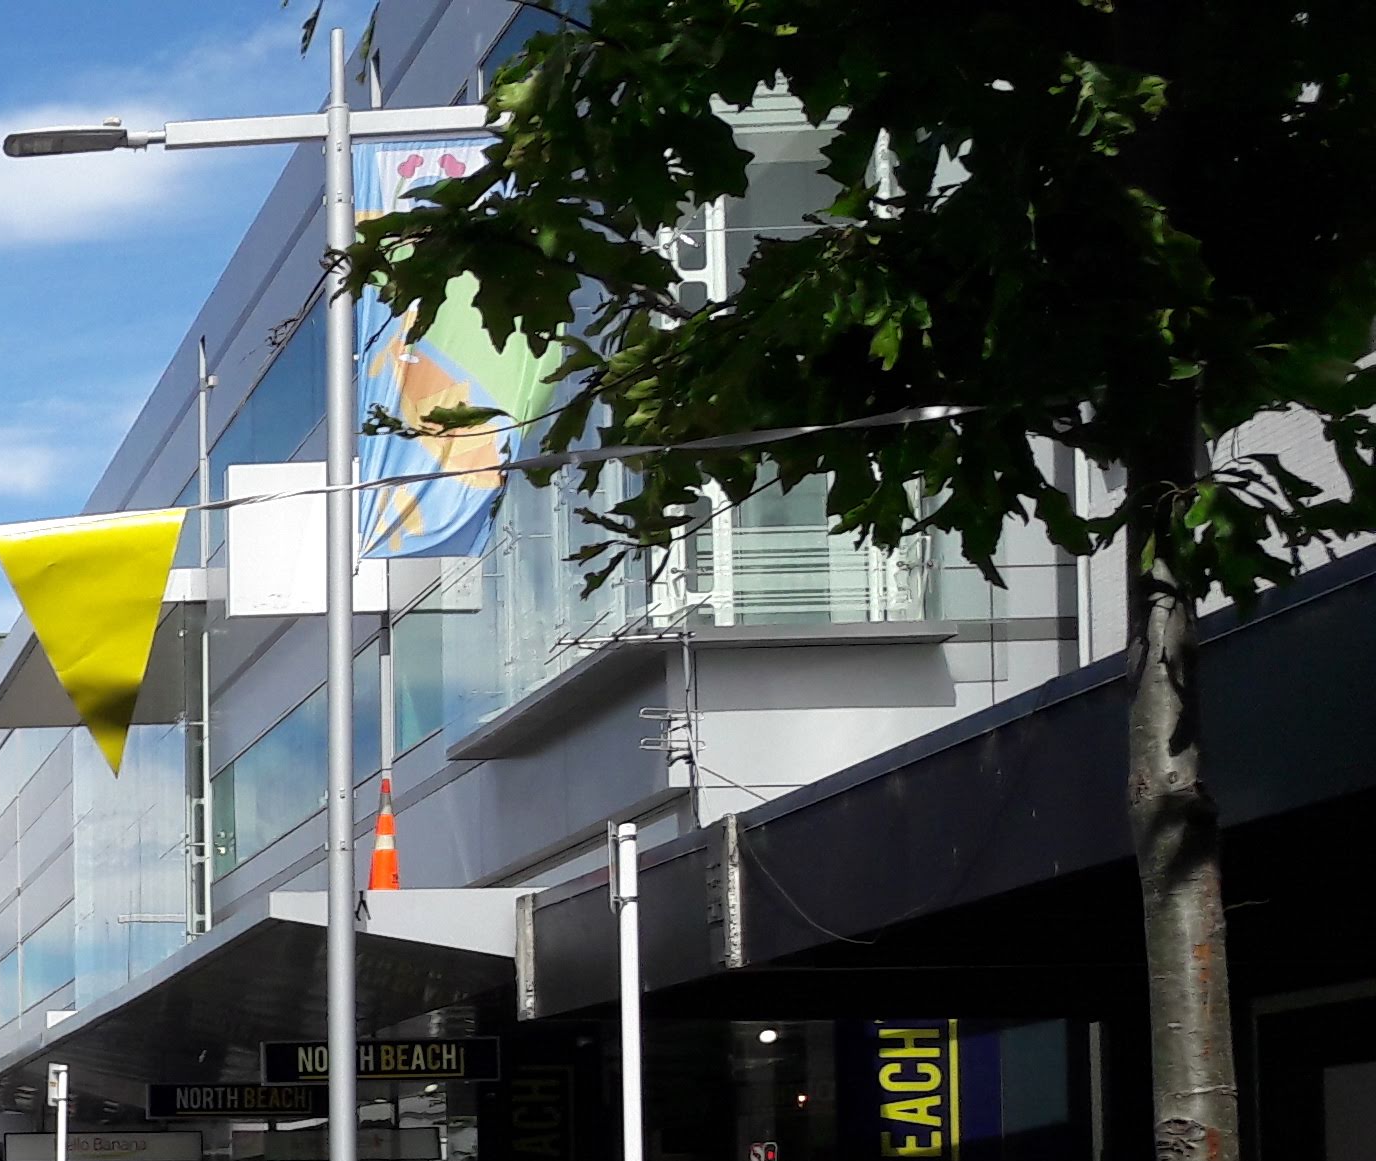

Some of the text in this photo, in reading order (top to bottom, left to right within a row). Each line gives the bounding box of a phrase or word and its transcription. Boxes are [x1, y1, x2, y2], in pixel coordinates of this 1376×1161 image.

[381, 1044, 457, 1071] BEACH
[176, 1086, 306, 1109] NORTH BEACH
